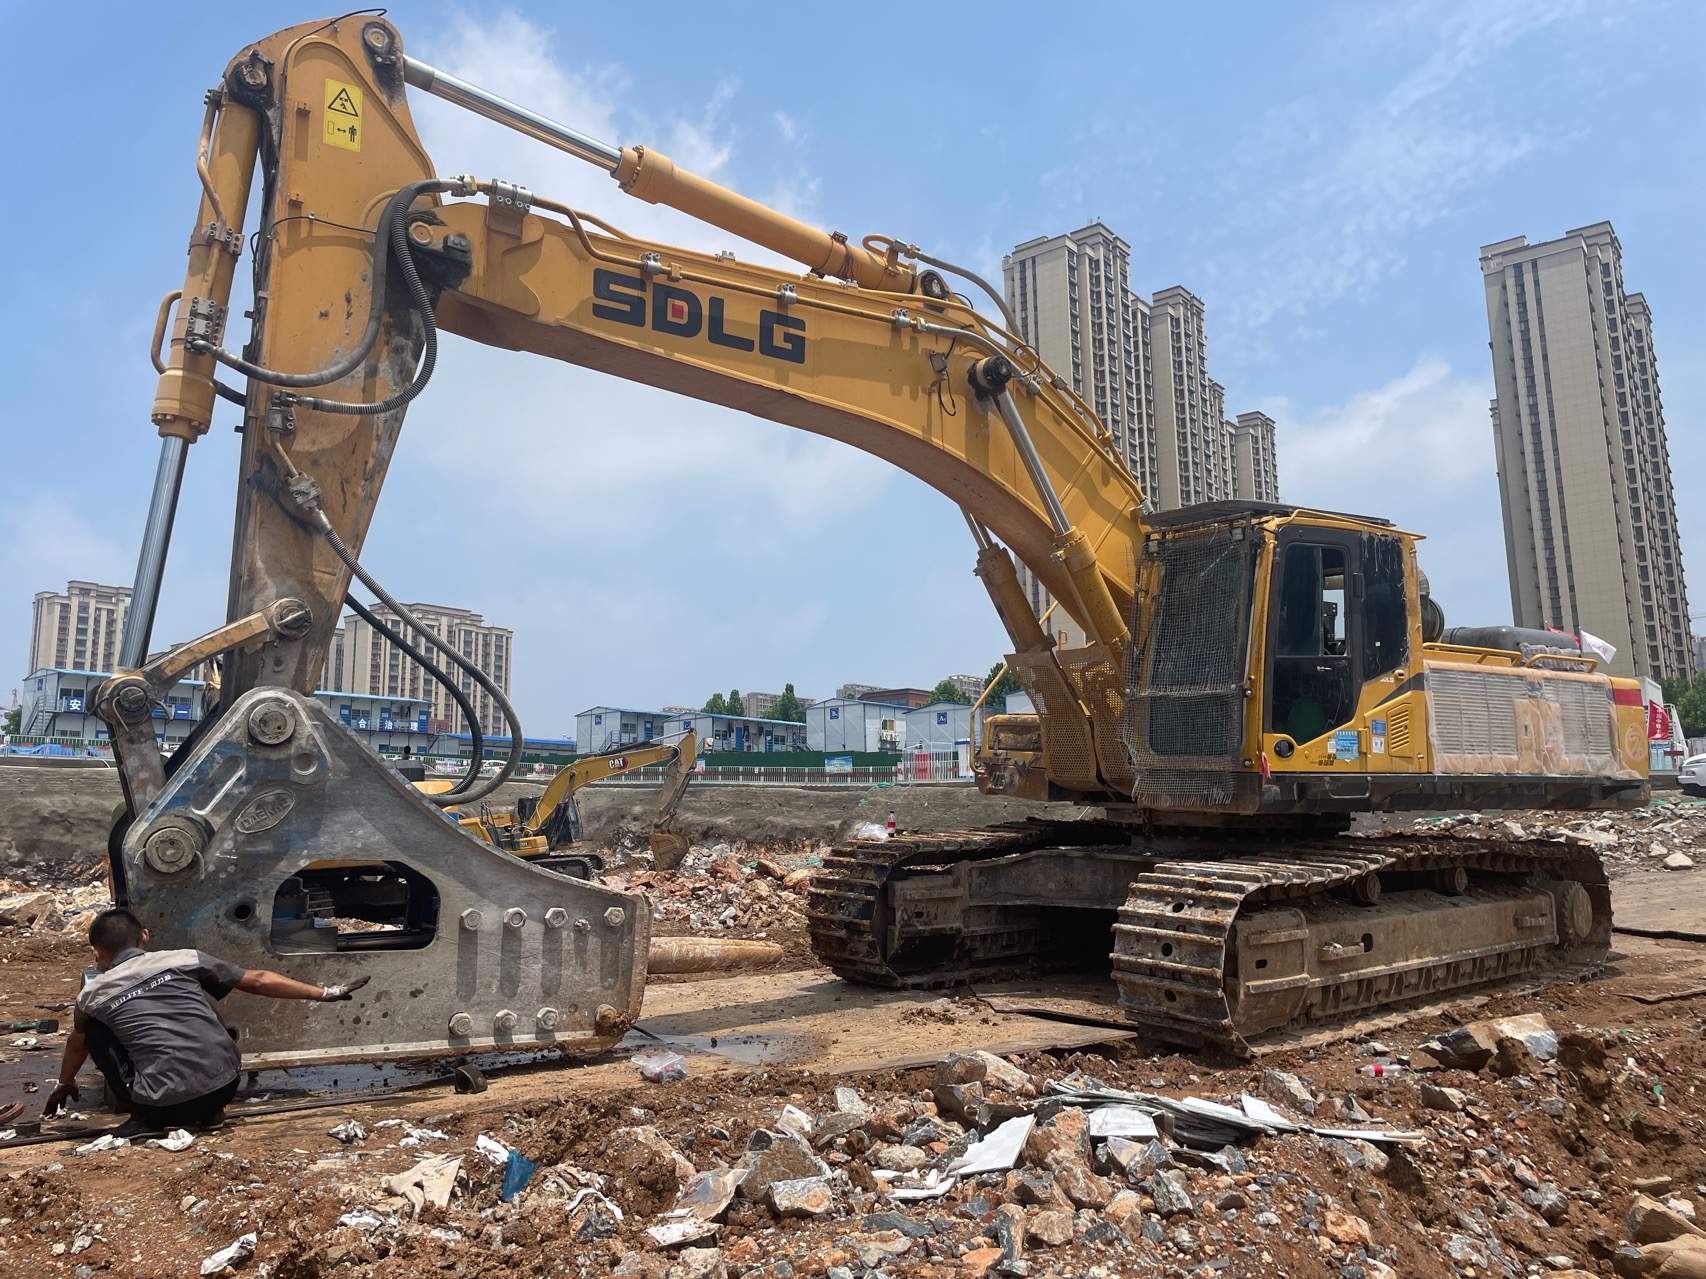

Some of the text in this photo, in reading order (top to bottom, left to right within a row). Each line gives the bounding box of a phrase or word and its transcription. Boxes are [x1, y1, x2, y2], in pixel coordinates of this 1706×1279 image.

[592, 267, 806, 364] SDLG
[69, 698, 81, 711] 安
[609, 757, 624, 769] CAT
